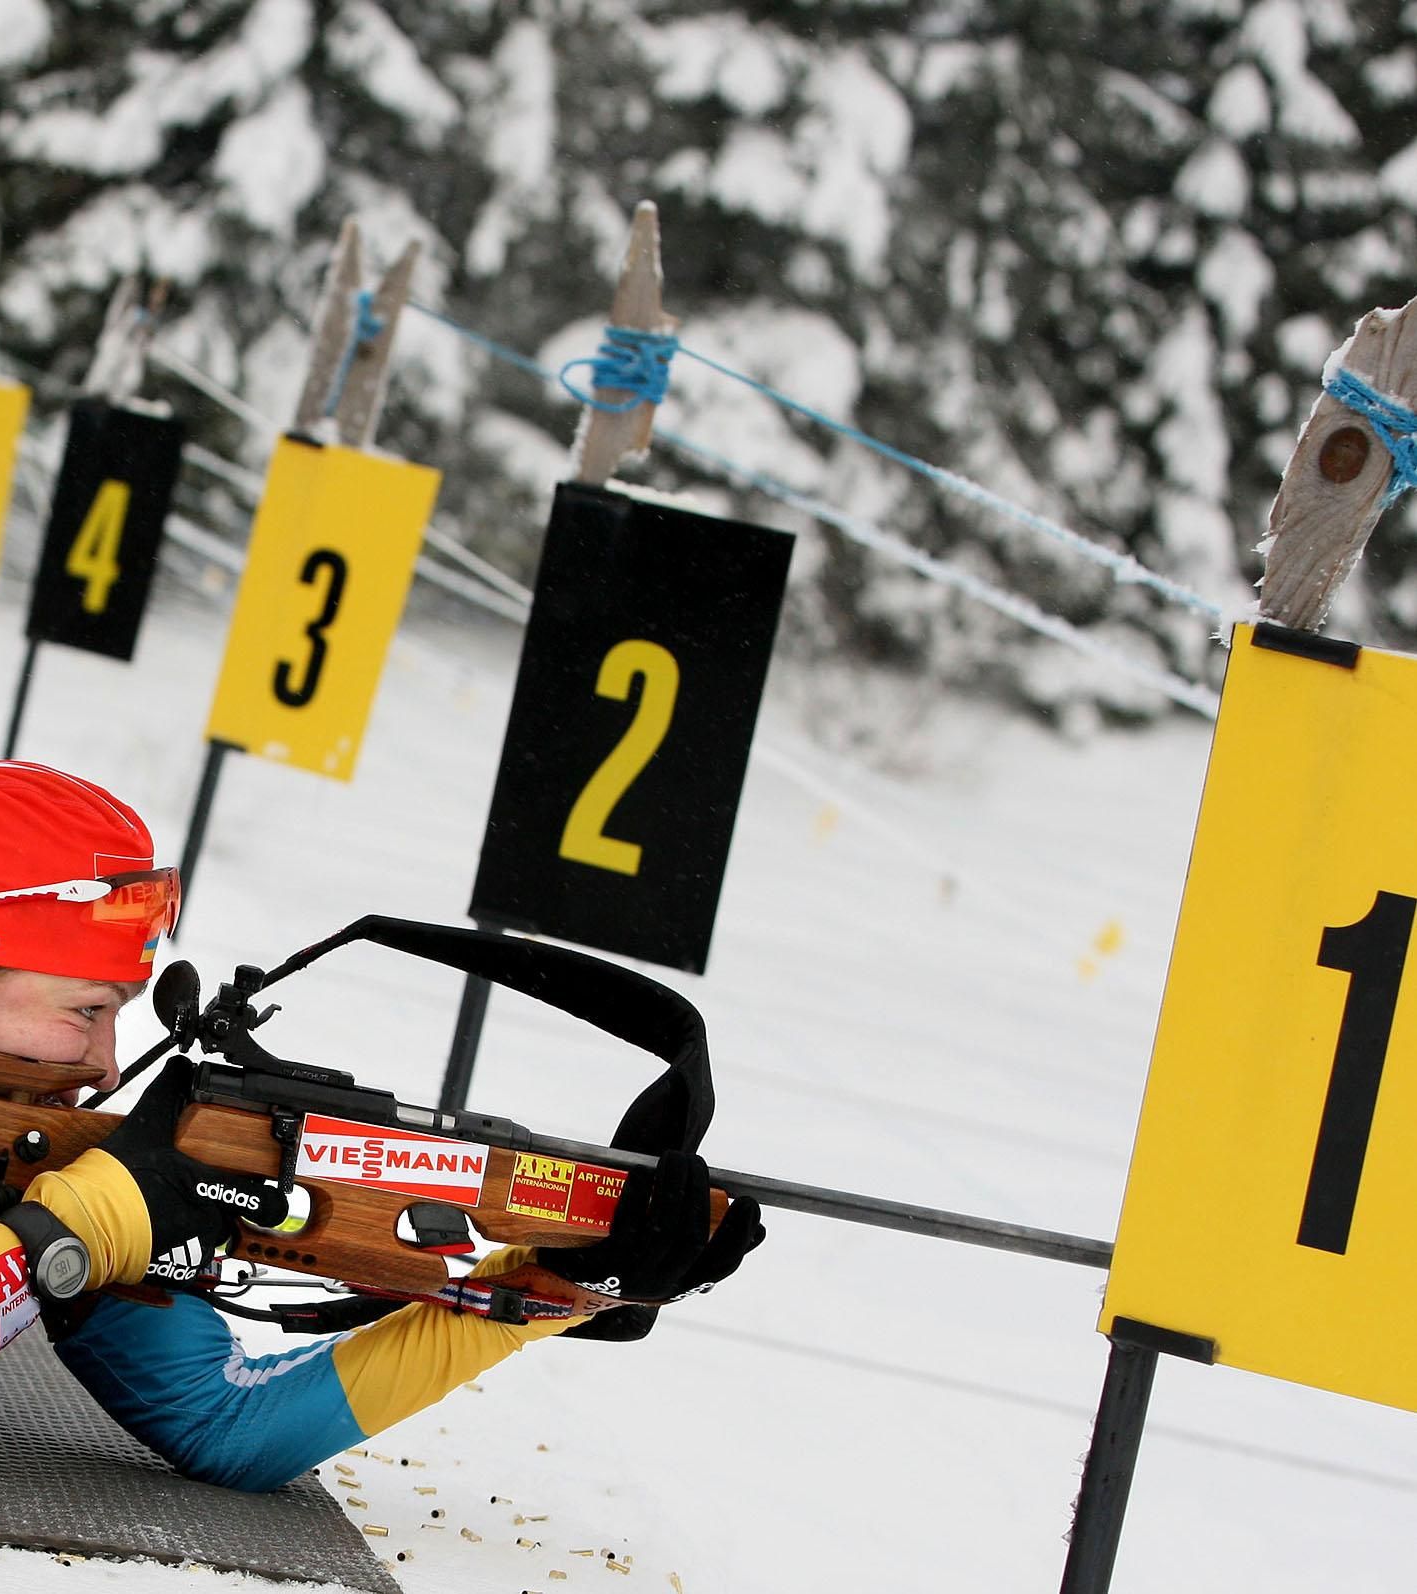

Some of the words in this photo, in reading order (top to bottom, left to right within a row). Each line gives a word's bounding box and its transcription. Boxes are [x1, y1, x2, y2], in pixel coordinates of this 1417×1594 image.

[66, 479, 131, 614] 4
[272, 548, 348, 709] 3
[559, 639, 680, 876] 2
[1296, 890, 1417, 1255] 1
[304, 1140, 482, 1179] VIESSMANN
[514, 1155, 573, 1184] ART
[515, 1176, 567, 1193] INTERNATIONAL
[577, 1171, 600, 1184] ART
[196, 1182, 261, 1210] adidas
[507, 1202, 566, 1220] DESIGN
[571, 1215, 610, 1227] www.ar
[146, 1261, 197, 1281] adida
[1, 1287, 32, 1317] INTERN
